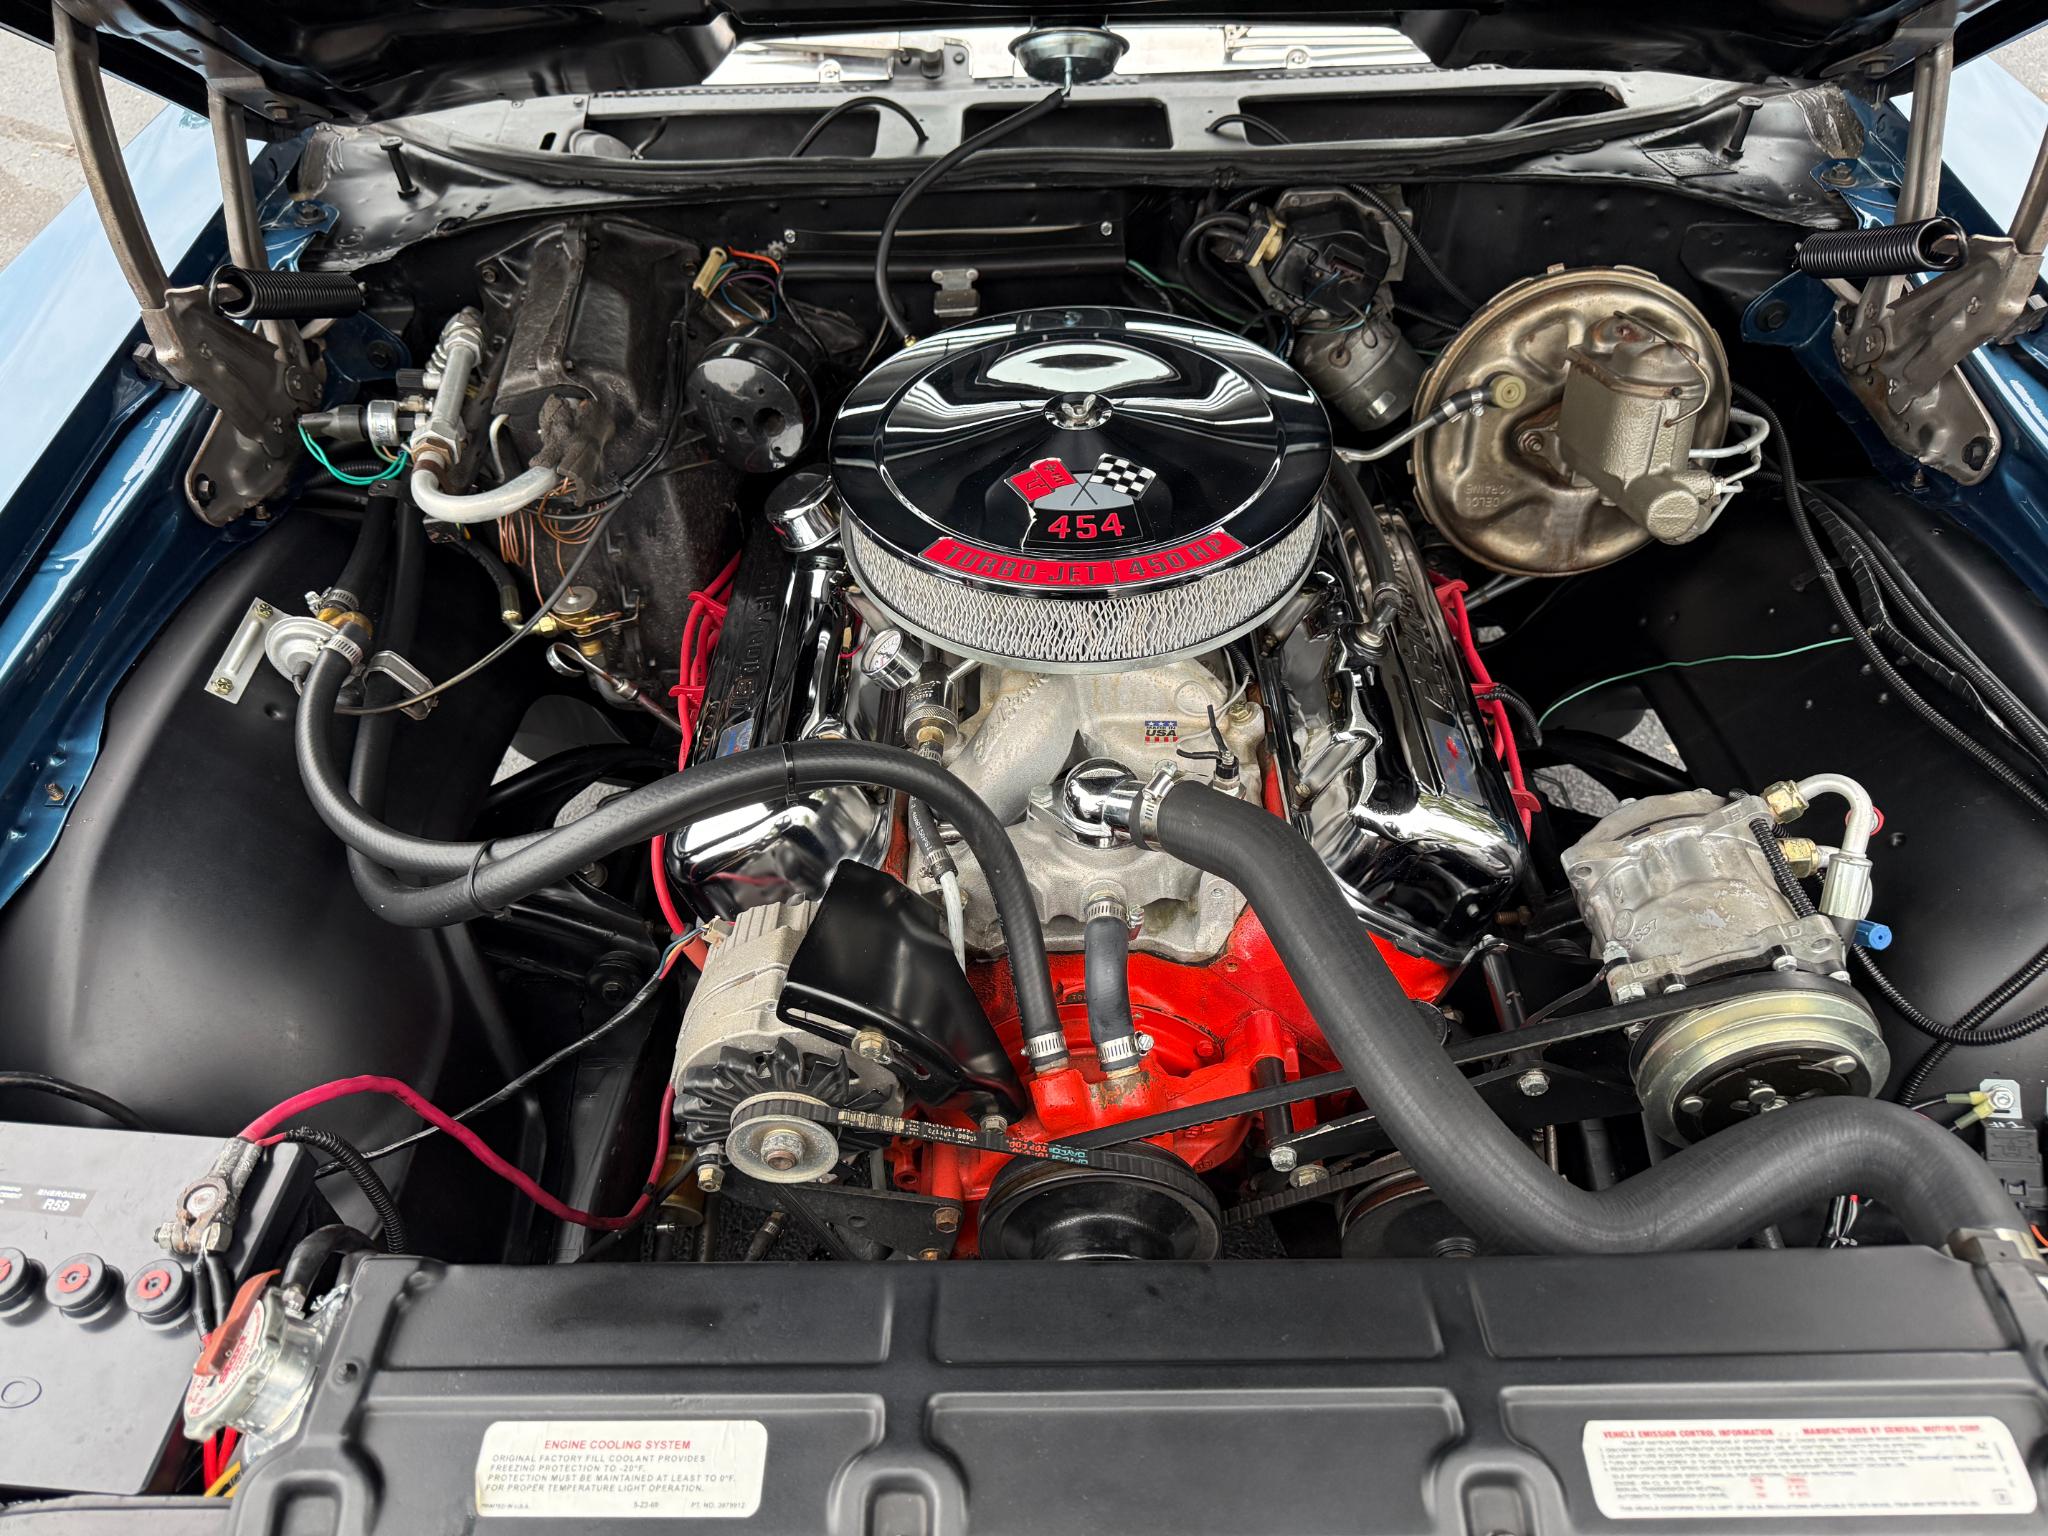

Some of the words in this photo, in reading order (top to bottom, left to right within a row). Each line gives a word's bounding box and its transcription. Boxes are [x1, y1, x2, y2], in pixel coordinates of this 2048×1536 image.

[1048, 513, 1125, 539] 454
[948, 544, 1098, 583] TURBO-JET
[1128, 545, 1186, 576] 450
[1191, 538, 1223, 562] HP
[42, 1199, 70, 1212] R59
[544, 1440, 586, 1450] ENGINE
[590, 1440, 642, 1450] COOLING
[645, 1440, 691, 1450] SYSTEM
[488, 1474, 547, 1482] PROTECTION
[550, 1474, 576, 1482] MUST
[580, 1474, 592, 1482] BE
[596, 1474, 654, 1482] MAINTAINED
[656, 1474, 668, 1482] AT
[671, 1474, 701, 1482] LEAST
[705, 1474, 717, 1482] TO
[485, 1484, 504, 1492] FOR
[507, 1484, 545, 1492] PROPER
[548, 1484, 616, 1492] TEMPERATURE
[618, 1484, 646, 1492] LIGHT
[649, 1484, 704, 1492] OPERATION.
